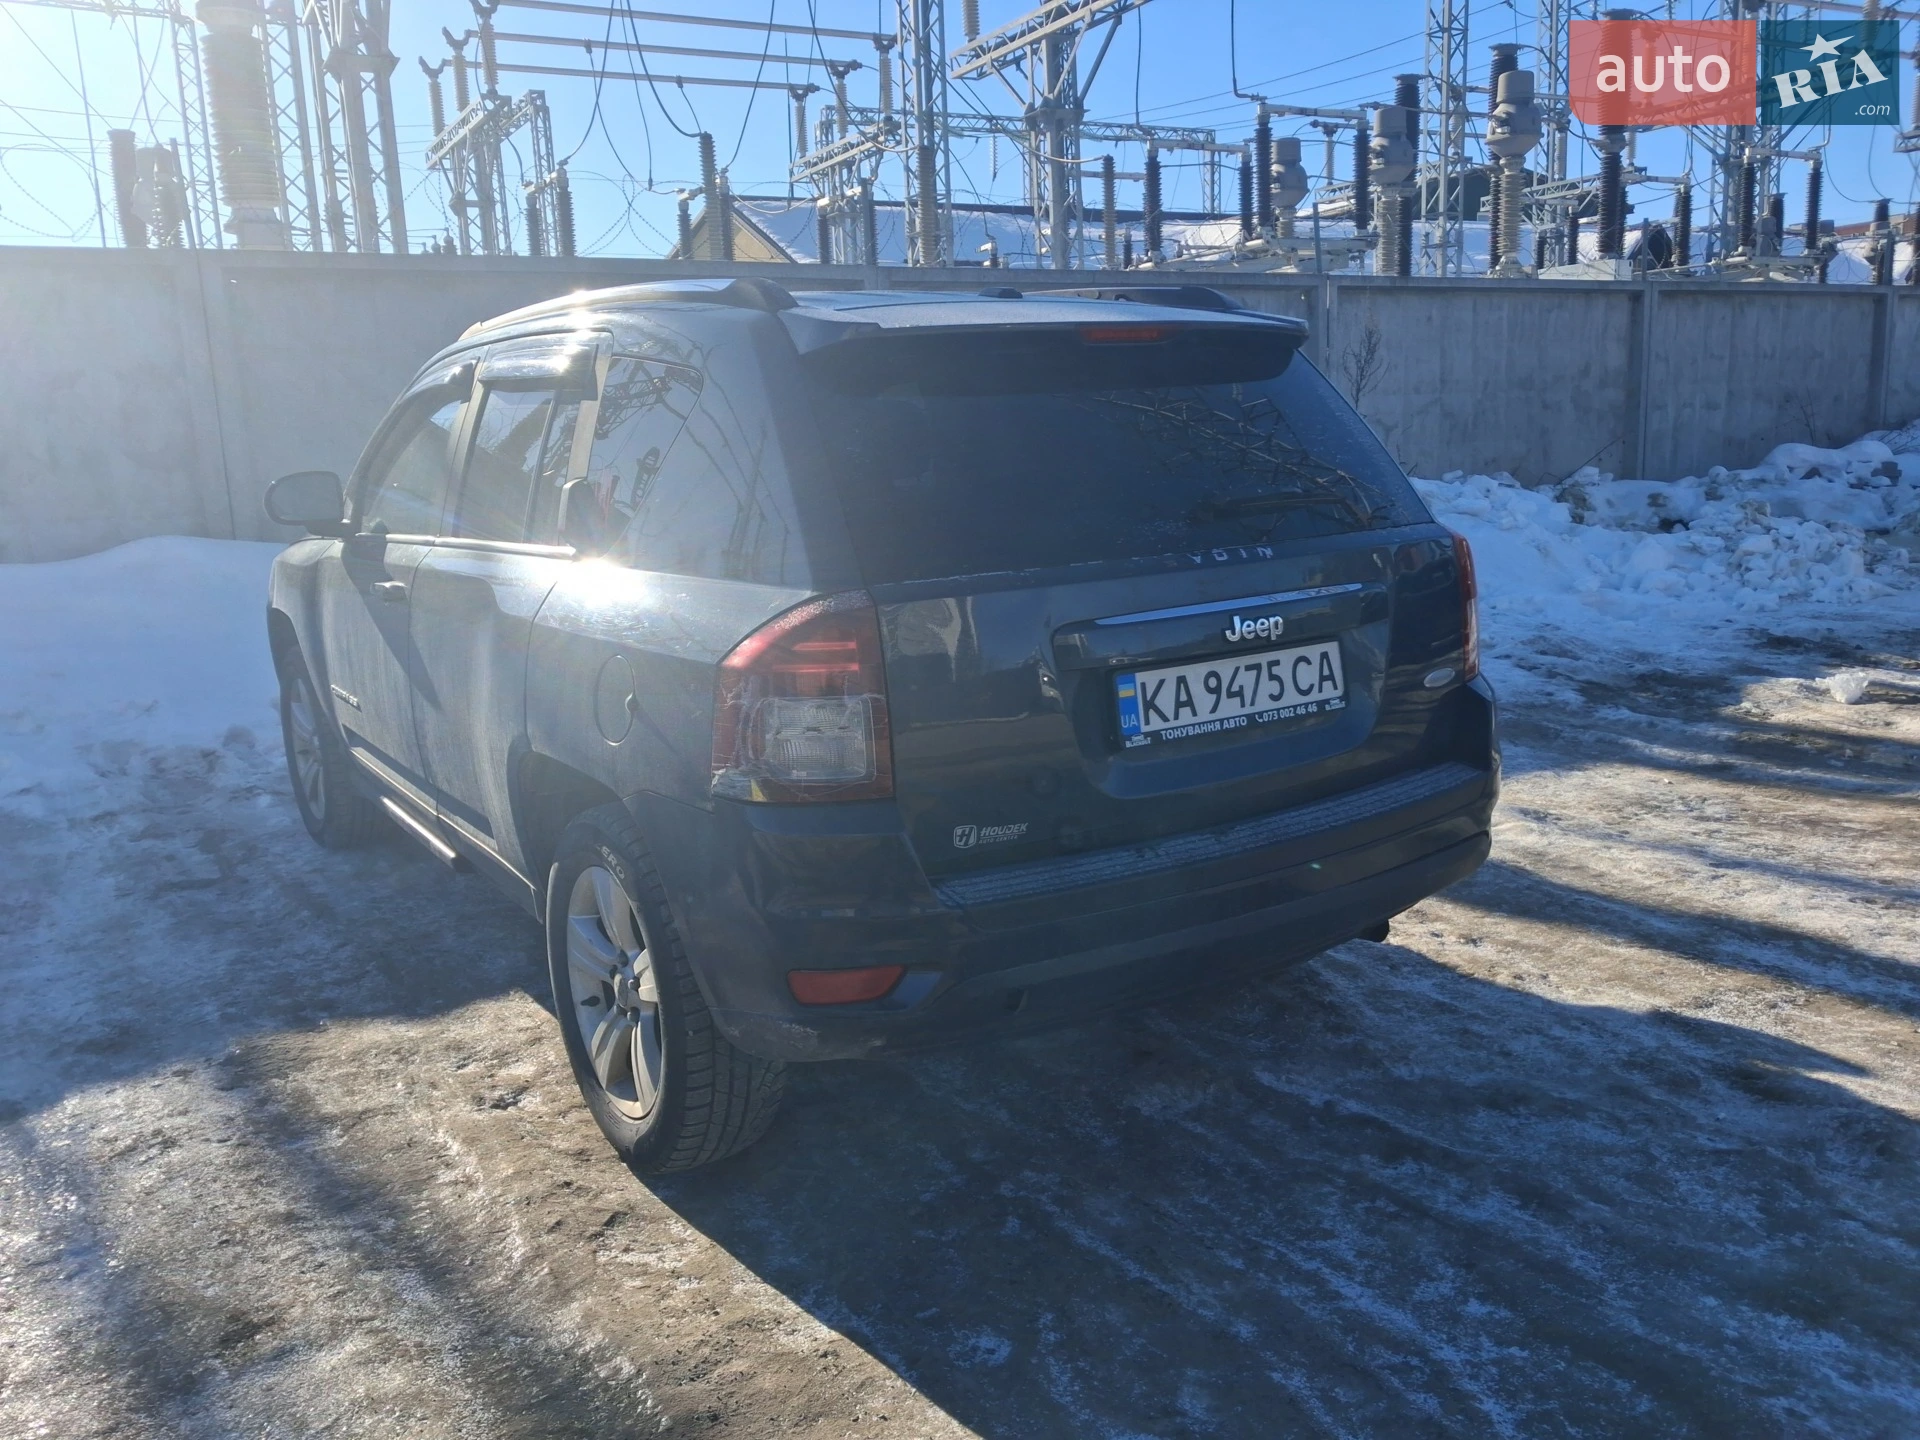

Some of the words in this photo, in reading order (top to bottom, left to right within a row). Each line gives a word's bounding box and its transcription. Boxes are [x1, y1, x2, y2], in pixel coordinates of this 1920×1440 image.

[1225, 615, 1284, 642] Jeep
[1120, 713, 1139, 728] UA
[1262, 711, 1278, 722] 073
[1280, 707, 1295, 718] 002
[1296, 704, 1306, 715] 46
[1307, 702, 1318, 713] 46
[1160, 722, 1221, 740] ТОНУВАННЯ
[1222, 716, 1248, 730] АВТО
